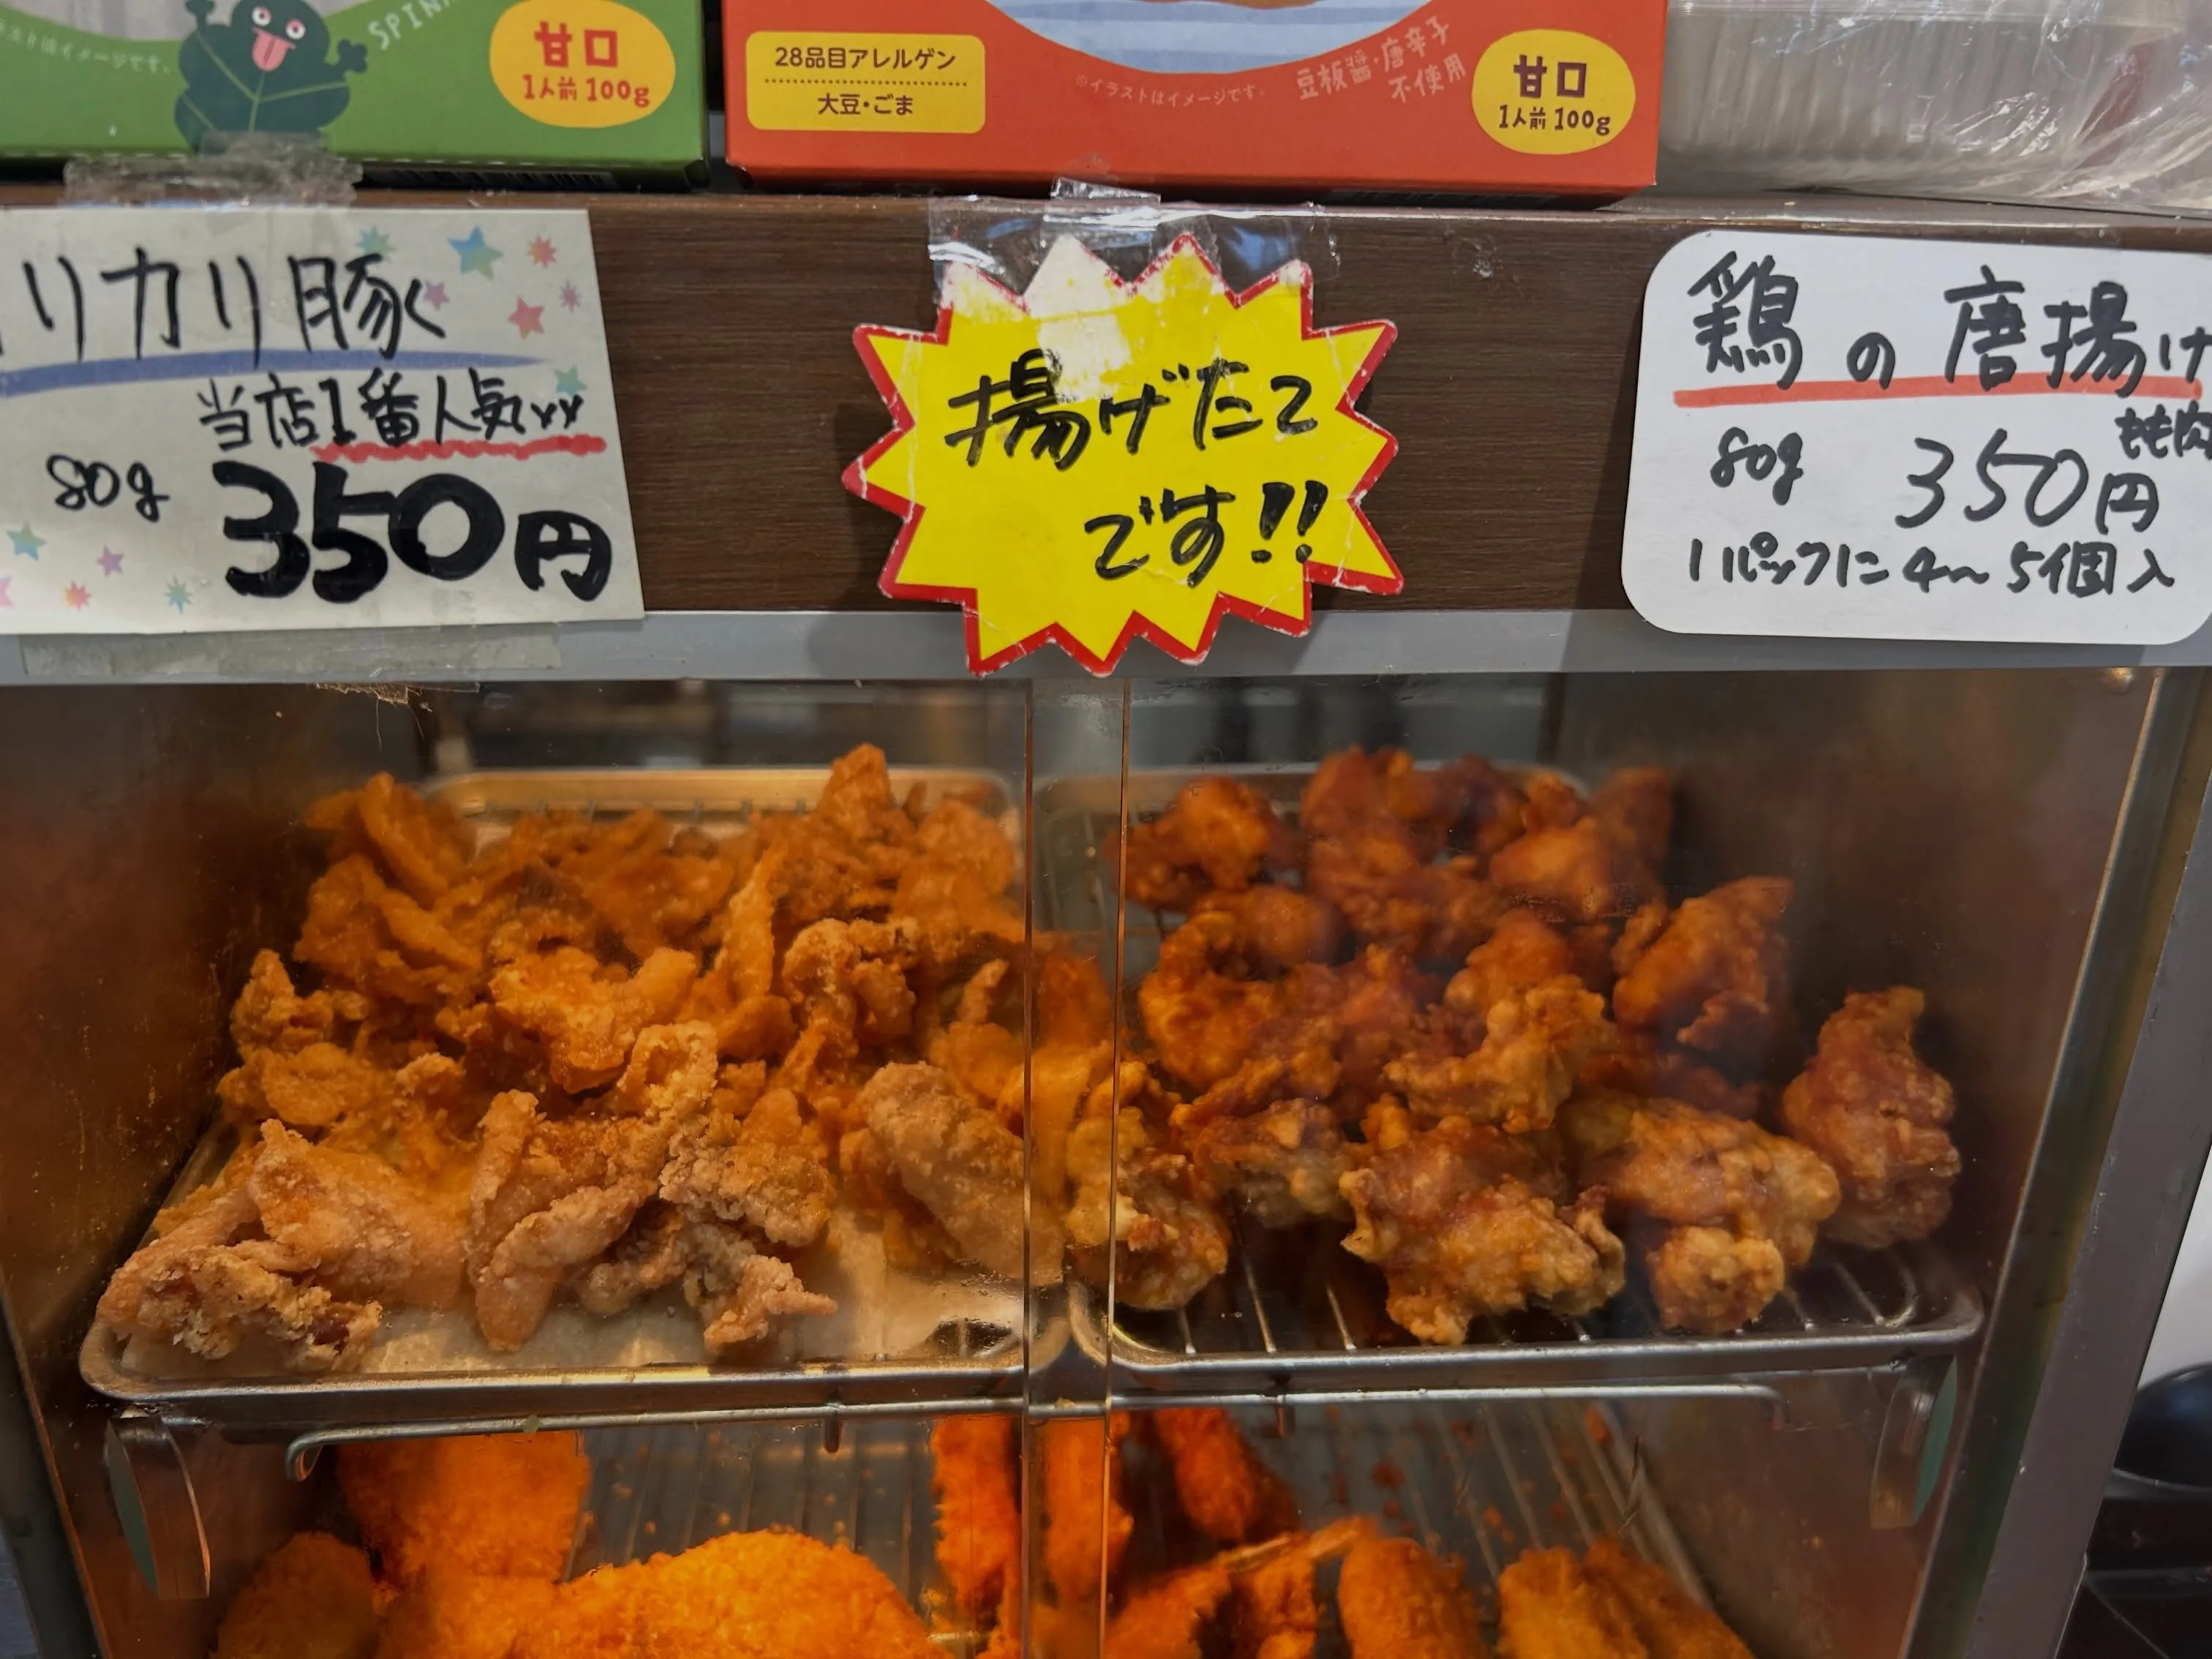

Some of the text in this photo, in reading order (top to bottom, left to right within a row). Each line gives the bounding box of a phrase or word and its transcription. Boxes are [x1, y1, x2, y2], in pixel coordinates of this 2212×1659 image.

[534, 20, 619, 68] 甘口
[775, 47, 956, 70] 28品目アレルゲン
[1513, 55, 1587, 99] 甘口
[818, 93, 914, 116] 大豆・ごま
[1388, 53, 1466, 104] 不使用
[0, 247, 445, 366] リカリ豚
[944, 348, 1318, 470] 揚げたて
[47, 455, 169, 522] 80g
[1710, 427, 1803, 505] 80g
[1895, 428, 2160, 534] 350円
[212, 461, 612, 603] 350円
